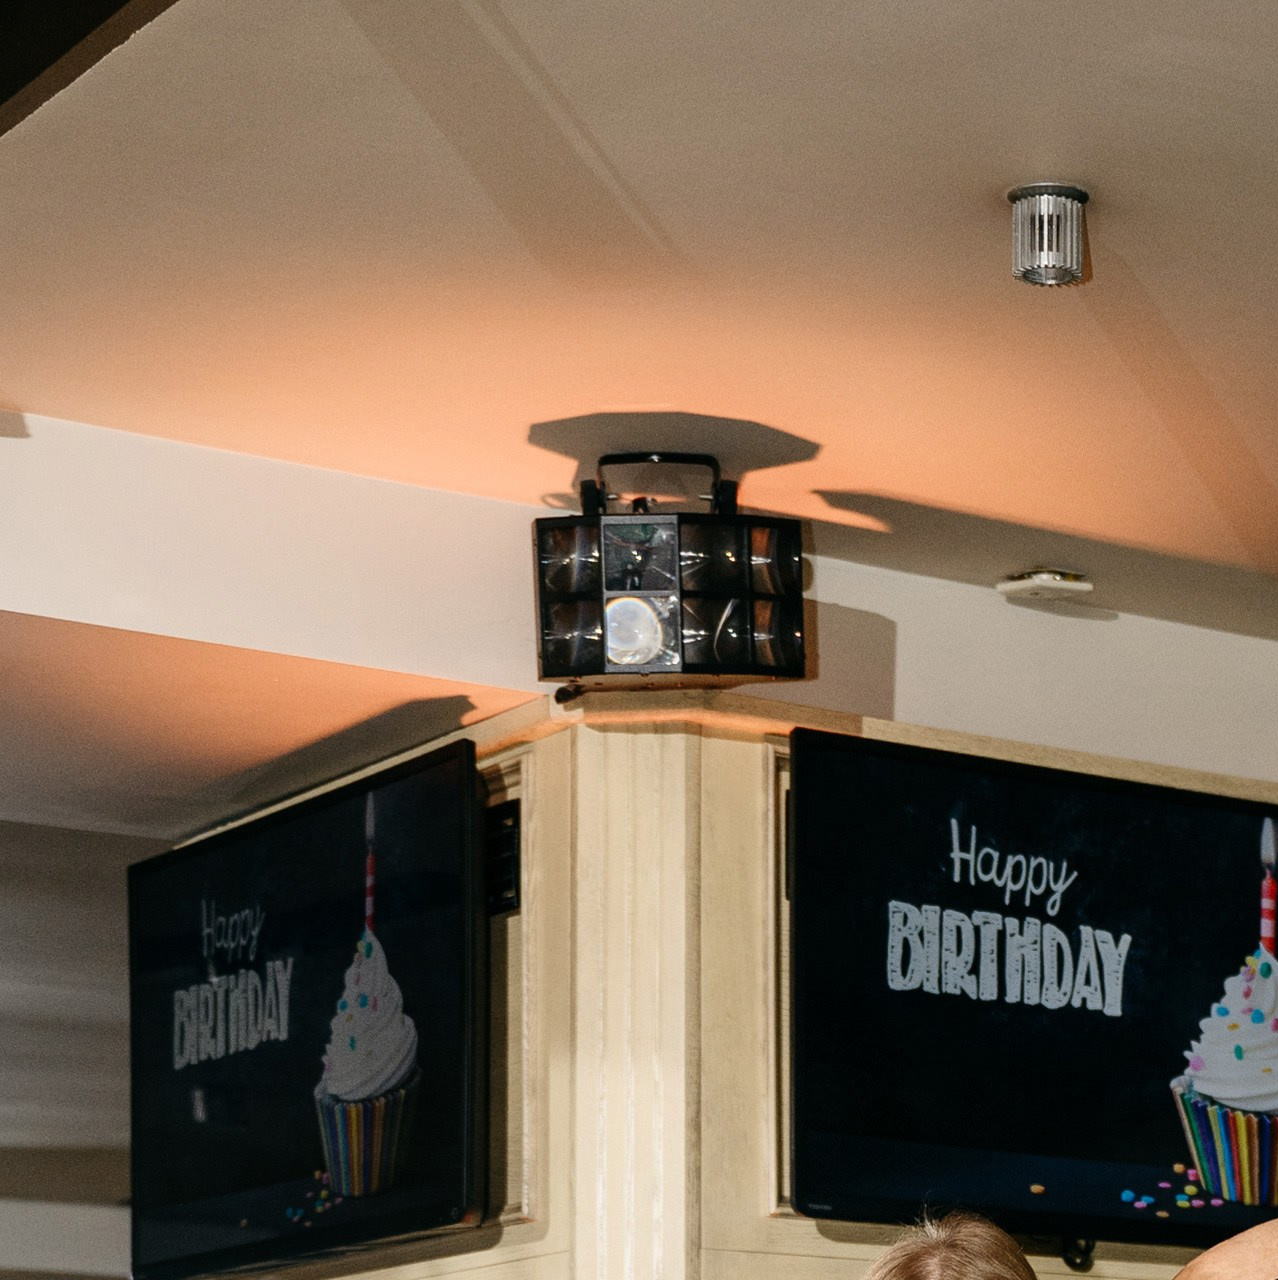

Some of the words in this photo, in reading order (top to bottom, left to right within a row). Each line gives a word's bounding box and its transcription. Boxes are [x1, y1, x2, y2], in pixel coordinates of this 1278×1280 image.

[950, 818, 1078, 916] Happy
[201, 897, 267, 963] Happy
[887, 900, 1132, 1017] BIRTHDAY
[173, 957, 294, 1071] BIRTHDAY
